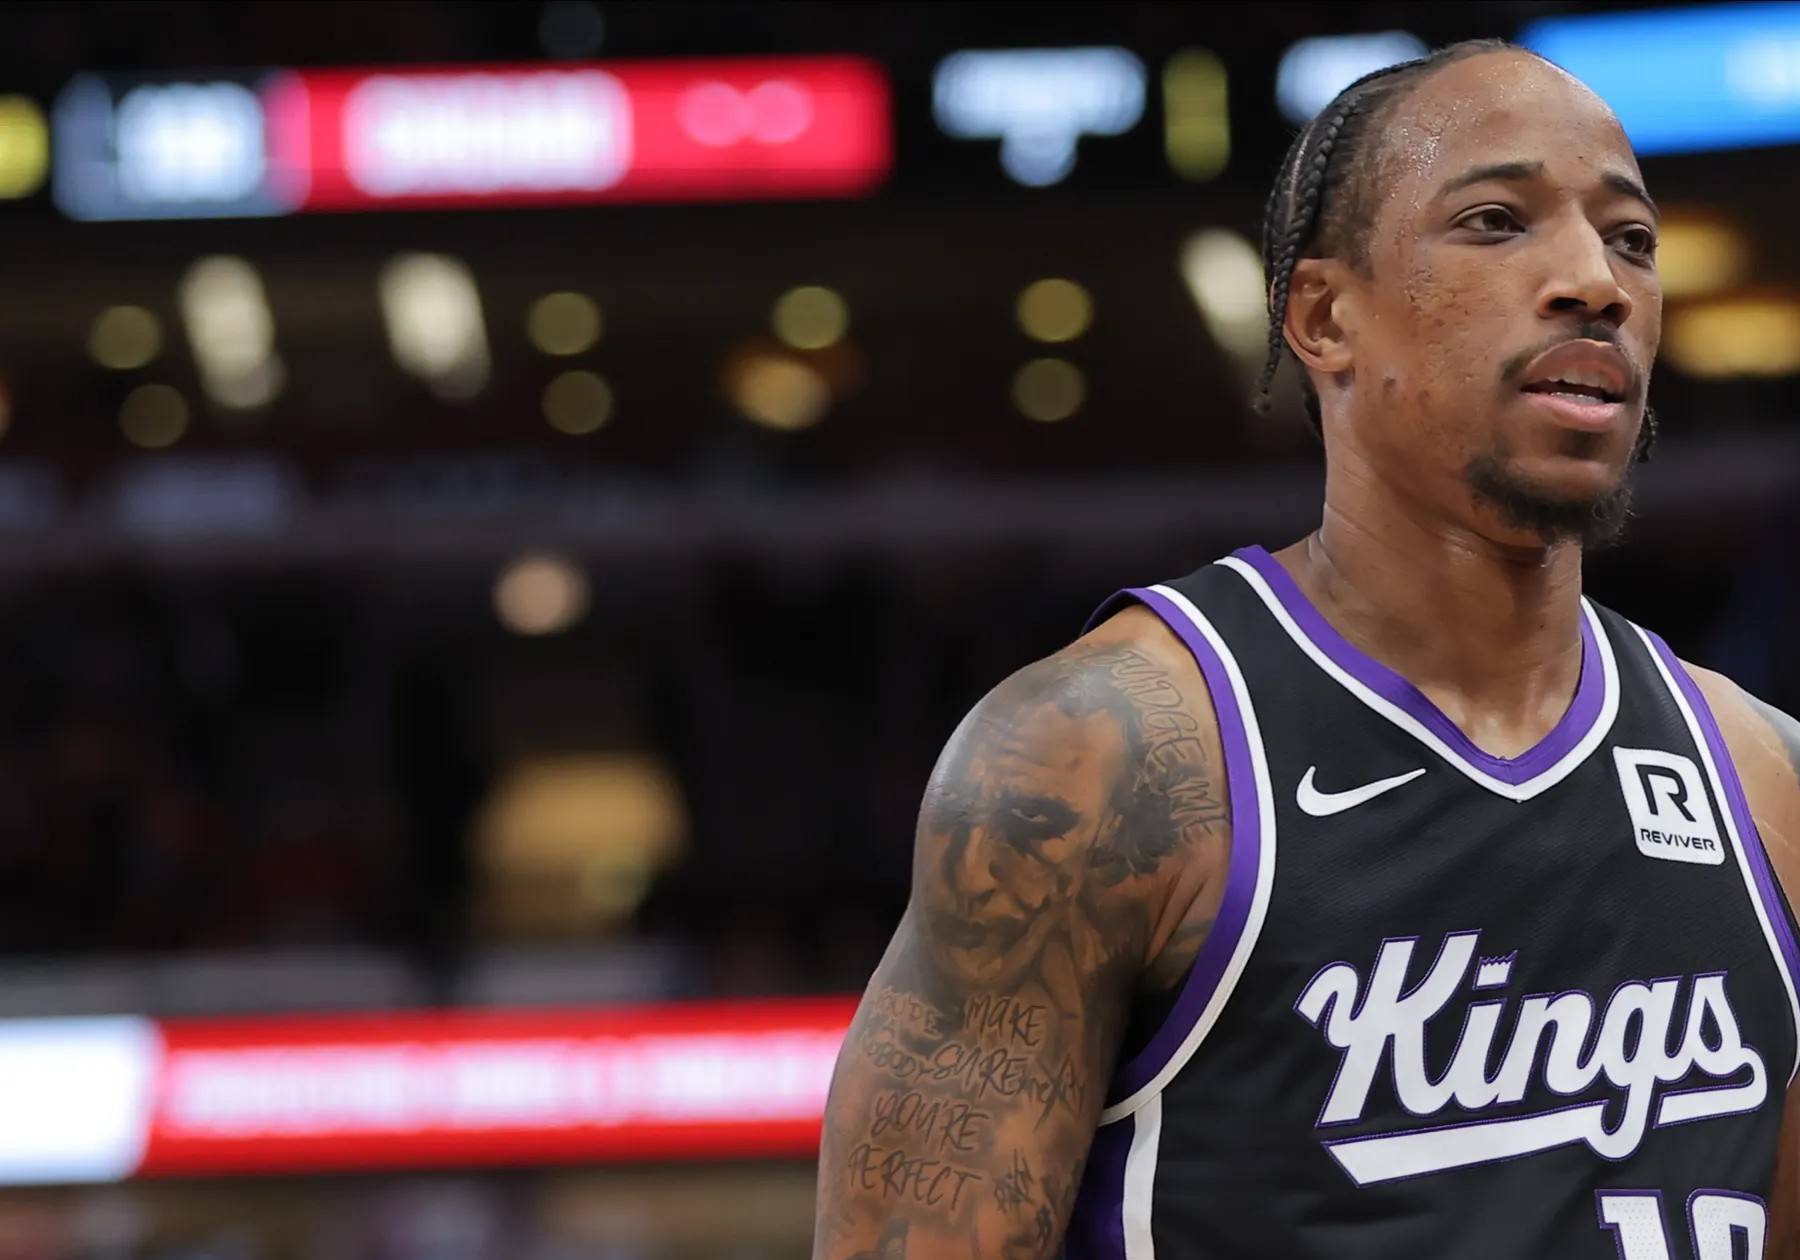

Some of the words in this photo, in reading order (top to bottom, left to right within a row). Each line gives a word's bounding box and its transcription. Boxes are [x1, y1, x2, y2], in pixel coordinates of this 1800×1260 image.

[1635, 764, 1697, 822] R
[1640, 828, 1716, 852] REVIVER
[934, 1043, 1028, 1098] SURE
[1293, 928, 1768, 1188] Kings
[871, 1092, 990, 1152] YOU'RE
[848, 1143, 983, 1211] PERFECT
